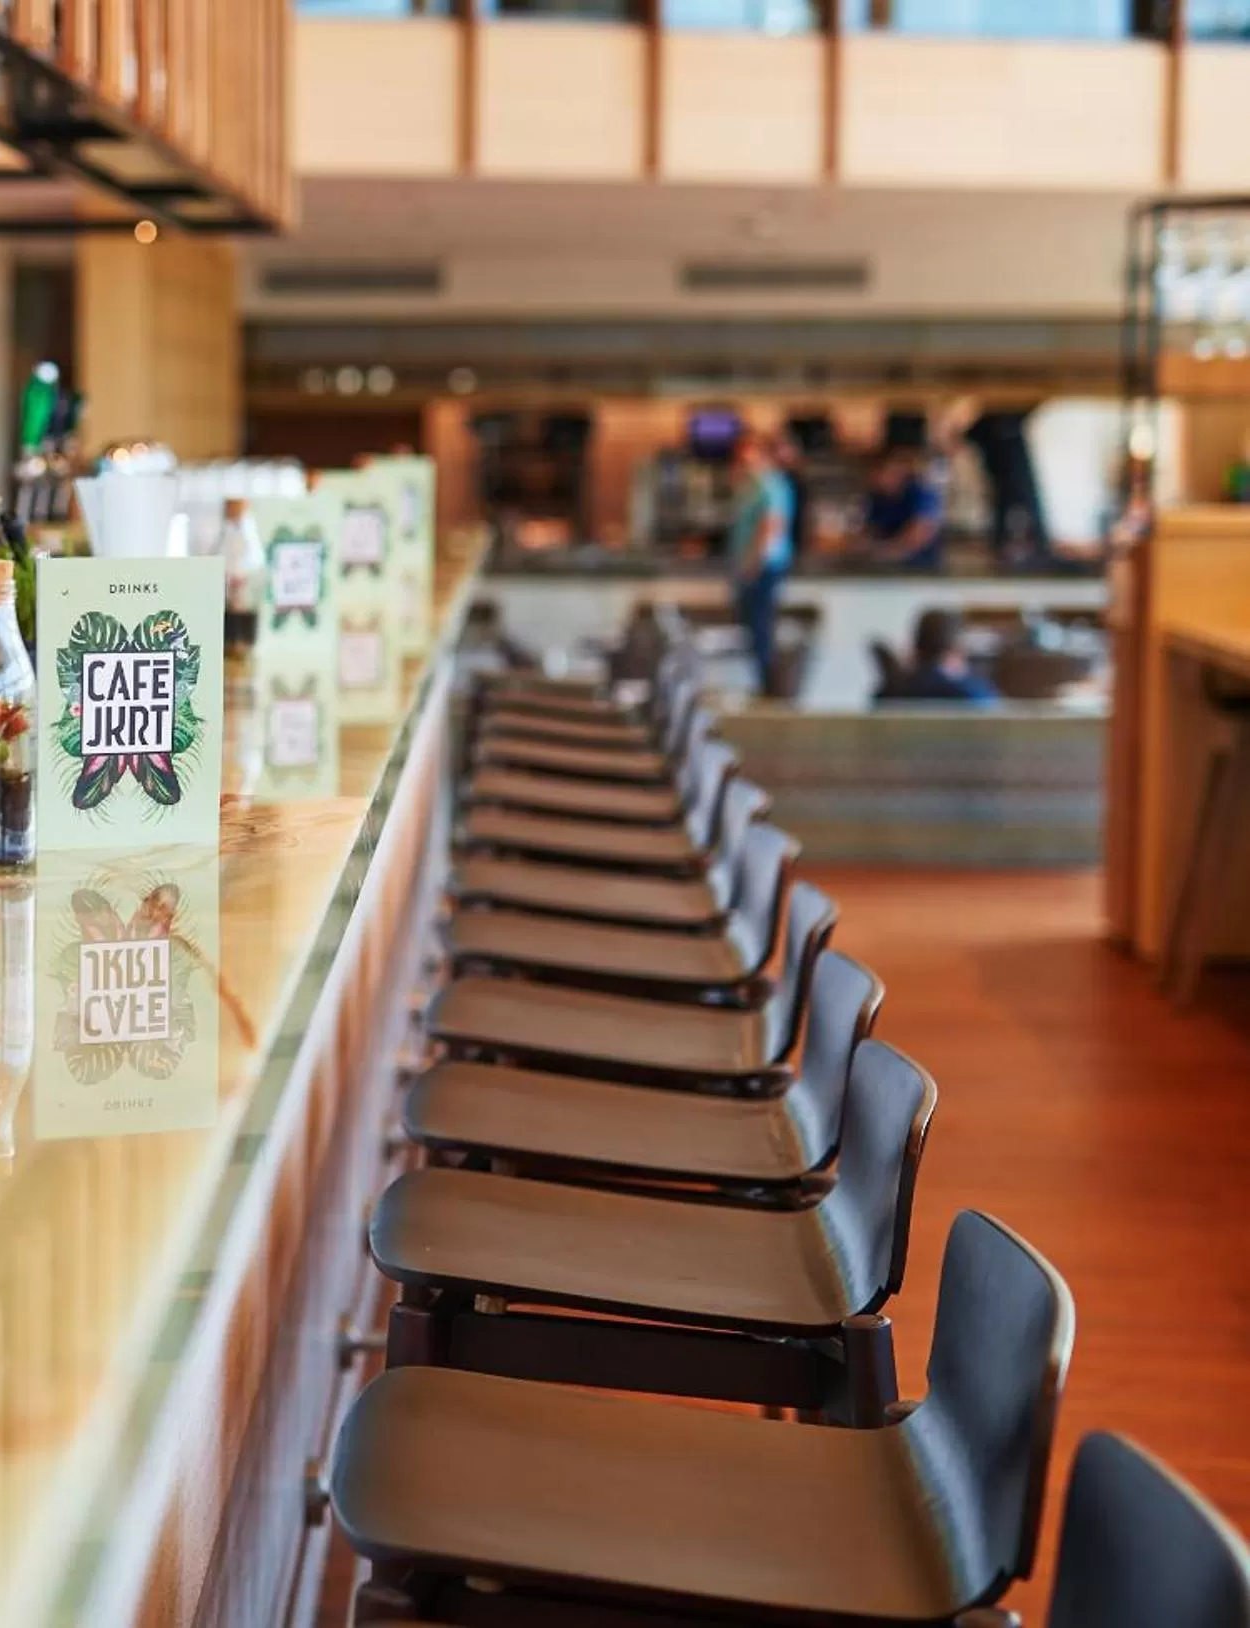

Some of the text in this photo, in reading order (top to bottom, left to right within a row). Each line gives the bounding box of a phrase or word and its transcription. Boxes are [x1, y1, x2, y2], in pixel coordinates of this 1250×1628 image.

[109, 583, 159, 594] DRINKS
[87, 659, 170, 702] CAFE
[86, 704, 169, 748] JKRT
